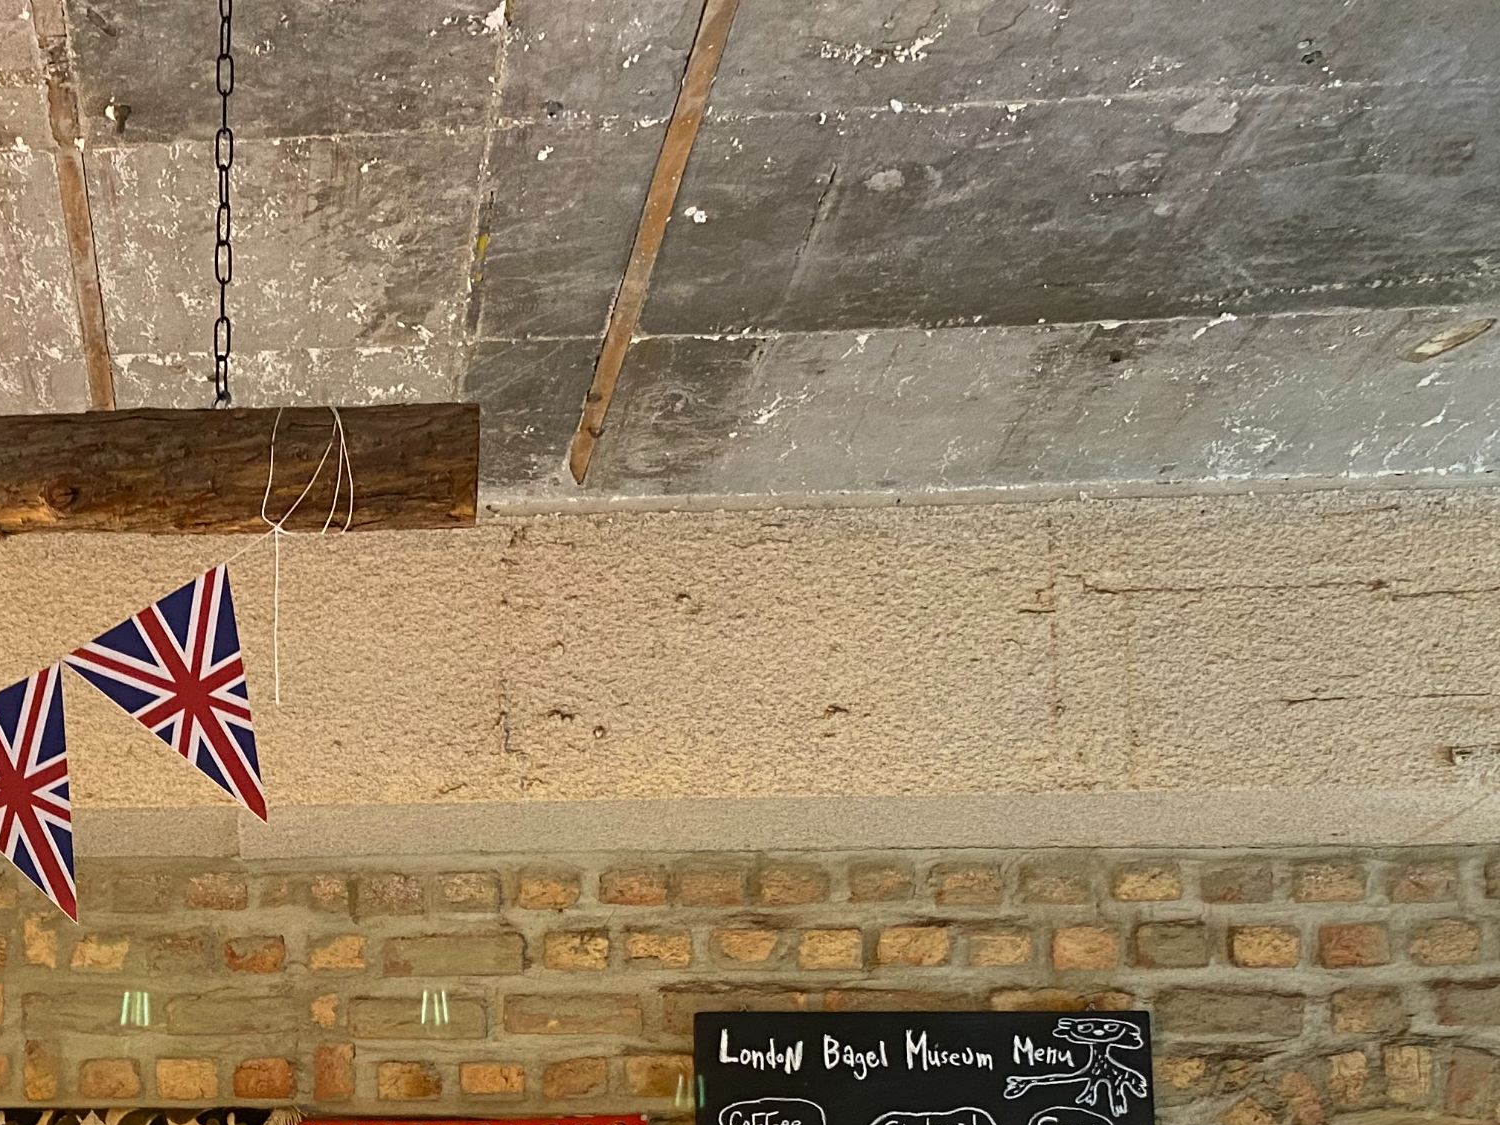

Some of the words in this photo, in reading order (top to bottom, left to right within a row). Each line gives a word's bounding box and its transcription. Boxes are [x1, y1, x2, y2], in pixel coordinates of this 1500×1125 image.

[824, 1034, 888, 1080] Bagel
[906, 1030, 993, 1071] Museum
[1013, 1035, 1075, 1067] Menu
